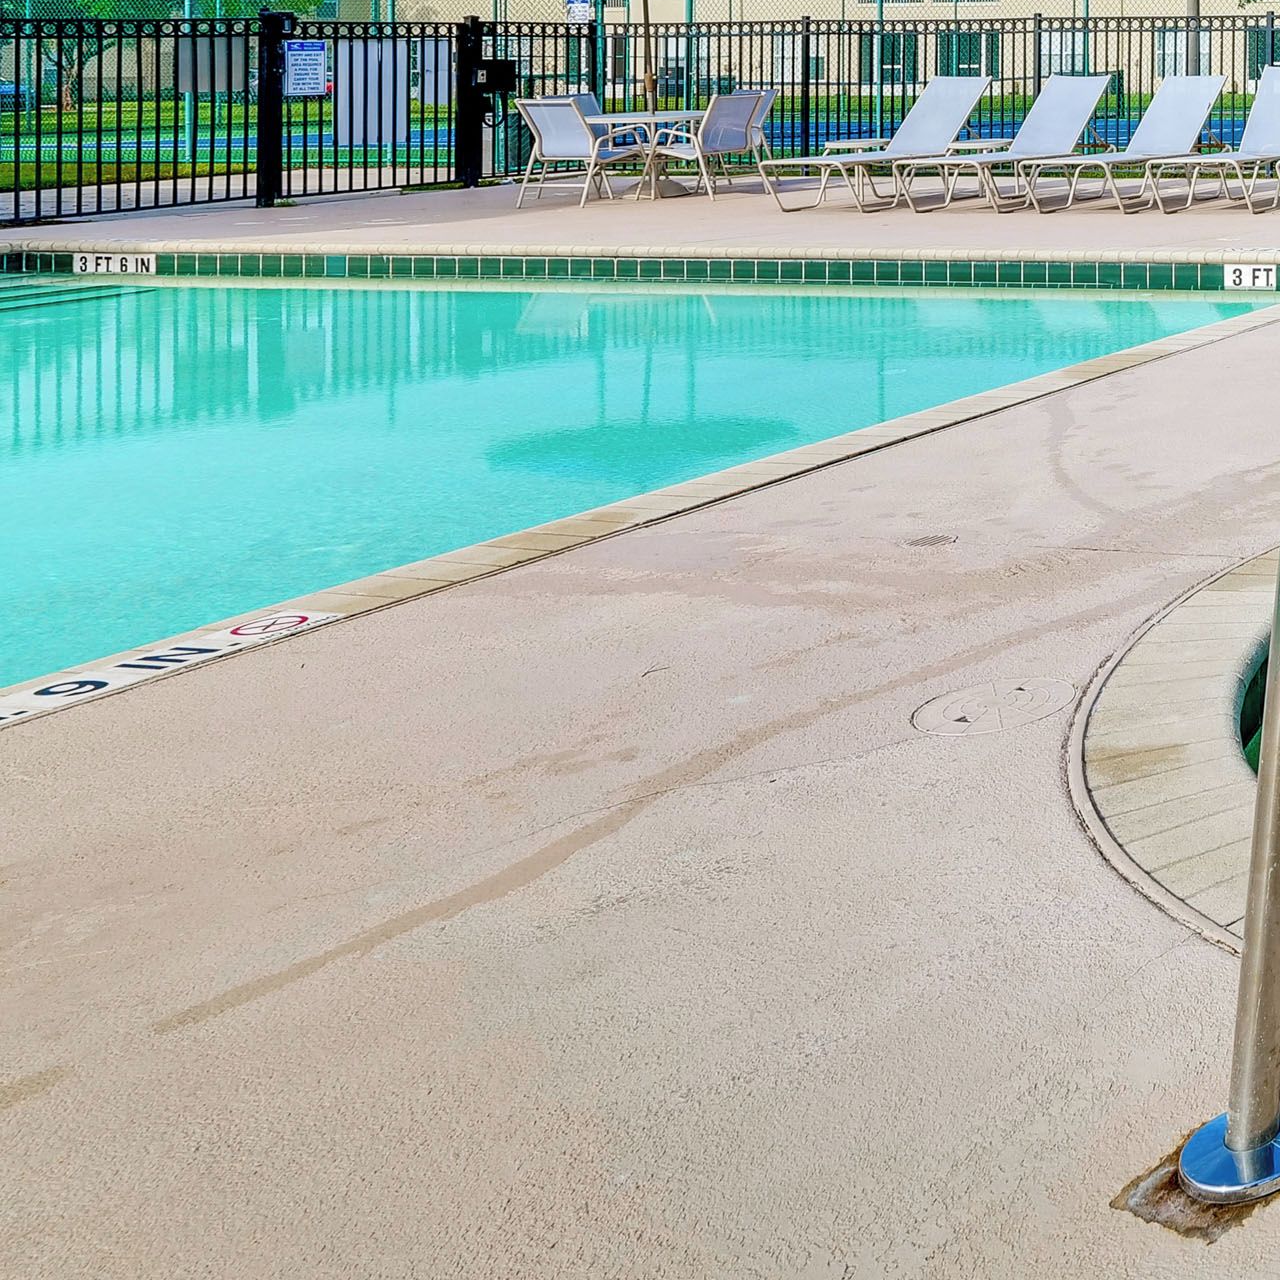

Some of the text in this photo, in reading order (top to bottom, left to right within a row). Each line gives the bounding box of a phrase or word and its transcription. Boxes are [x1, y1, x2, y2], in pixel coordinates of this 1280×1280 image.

[80, 256, 88, 272] 3
[120, 257, 128, 273] 6
[135, 257, 150, 273] IN
[1232, 268, 1242, 286] 3
[33, 680, 109, 697] 9
